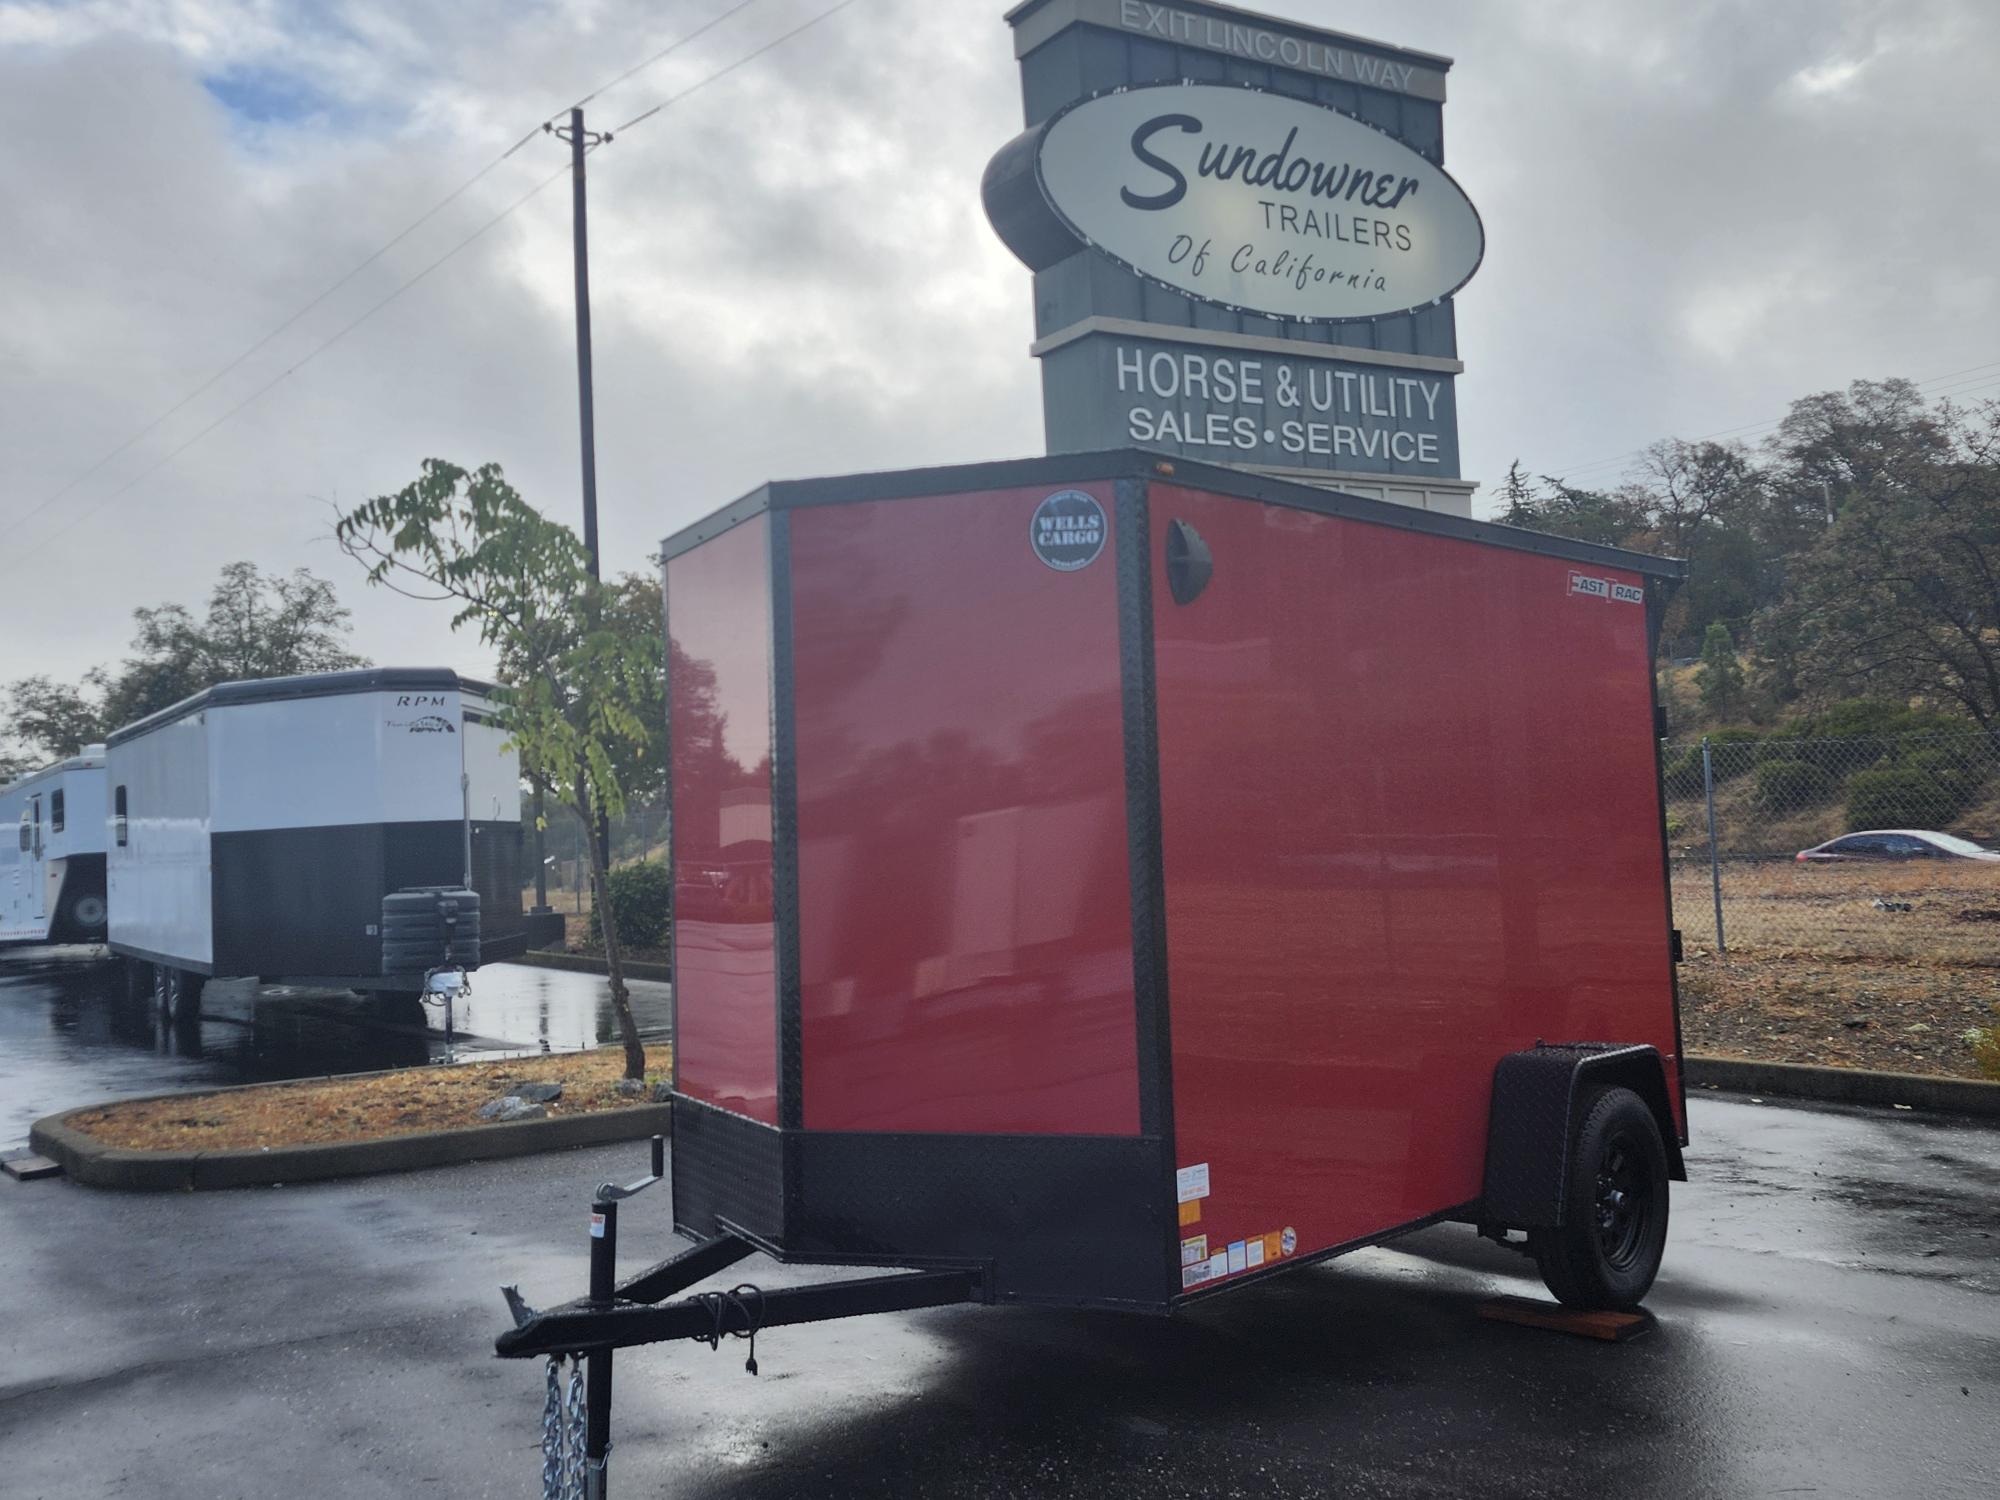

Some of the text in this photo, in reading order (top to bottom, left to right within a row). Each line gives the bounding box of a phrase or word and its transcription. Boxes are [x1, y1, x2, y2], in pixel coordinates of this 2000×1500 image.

[1120, 0, 1415, 90] EXIT LINCOLN WAY
[1120, 113, 1419, 211] Sundowner
[1258, 200, 1412, 252] TRAILERS
[1168, 234, 1387, 292] Of California
[1116, 346, 1441, 421] HORSE & UTILITY
[1128, 407, 1440, 464] SALES SERVICE
[1038, 514, 1099, 531] WELLS
[1038, 530, 1099, 546] CARGO
[397, 695, 446, 707] RPM
